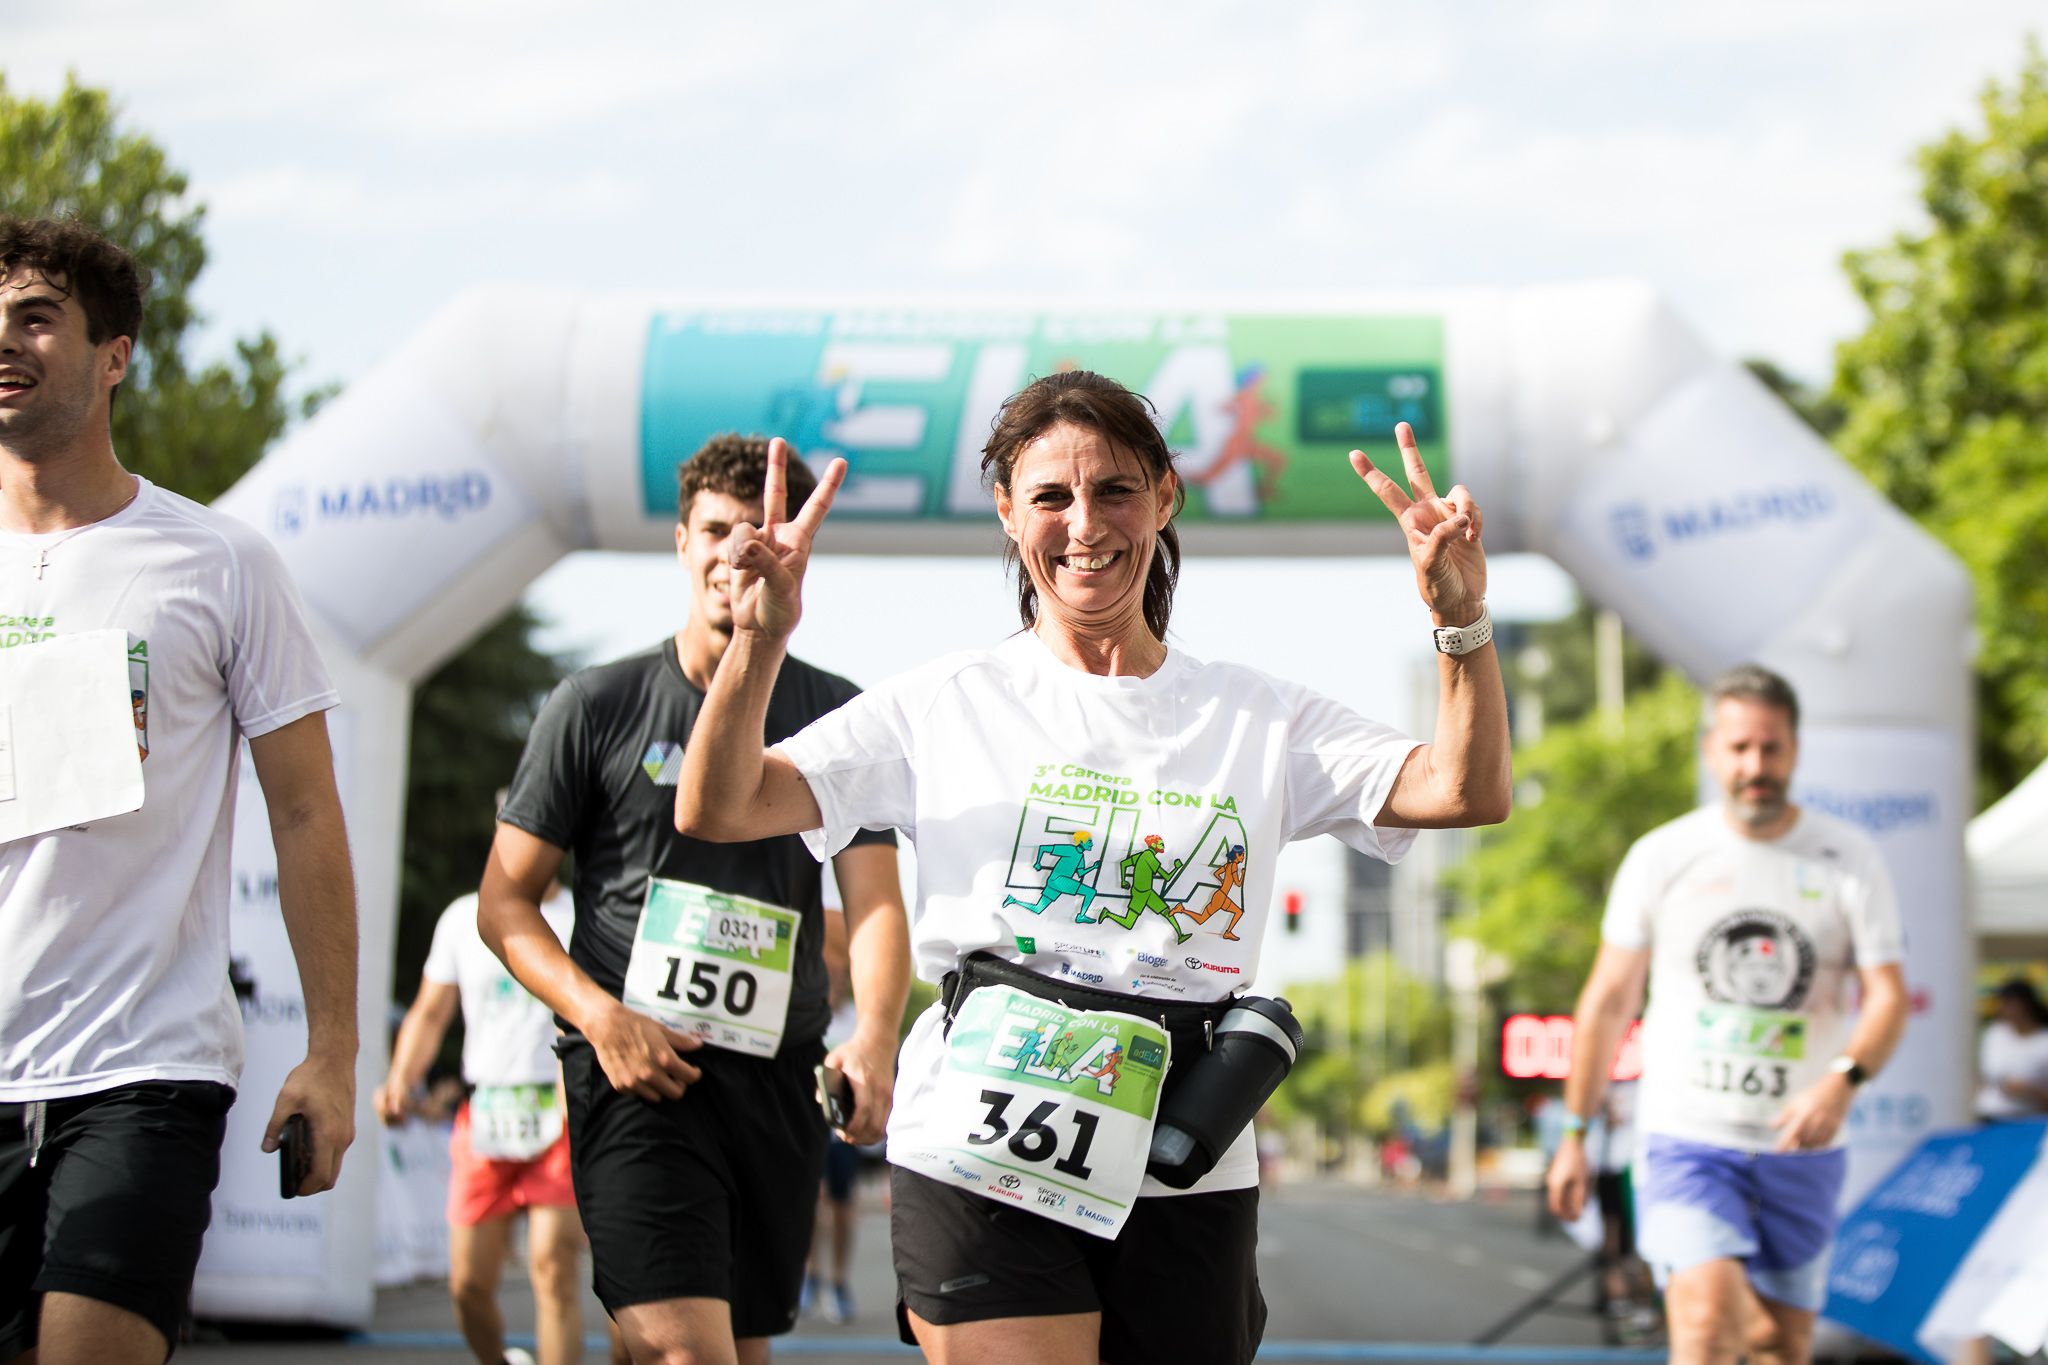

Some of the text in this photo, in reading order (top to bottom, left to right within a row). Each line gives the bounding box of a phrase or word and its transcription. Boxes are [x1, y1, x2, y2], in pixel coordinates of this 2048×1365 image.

[318, 467, 492, 522] MADRID
[1060, 763, 1132, 786] Carrera
[1029, 782, 1238, 814] MADRID CON LA
[1005, 798, 1248, 914] ELA
[719, 917, 759, 942] 0321
[656, 956, 759, 1017] 150
[1070, 969, 1104, 983] MADRID
[1008, 1000, 1121, 1036] MADRID CON LA
[984, 1012, 1119, 1097] ELA
[1695, 1059, 1788, 1098] 1163
[967, 1088, 1100, 1181] 361
[952, 1164, 982, 1183] Biogen
[1037, 1186, 1062, 1200] SPORT
[1037, 1194, 1057, 1207] LIFE
[1084, 1209, 1115, 1227] MADRID
